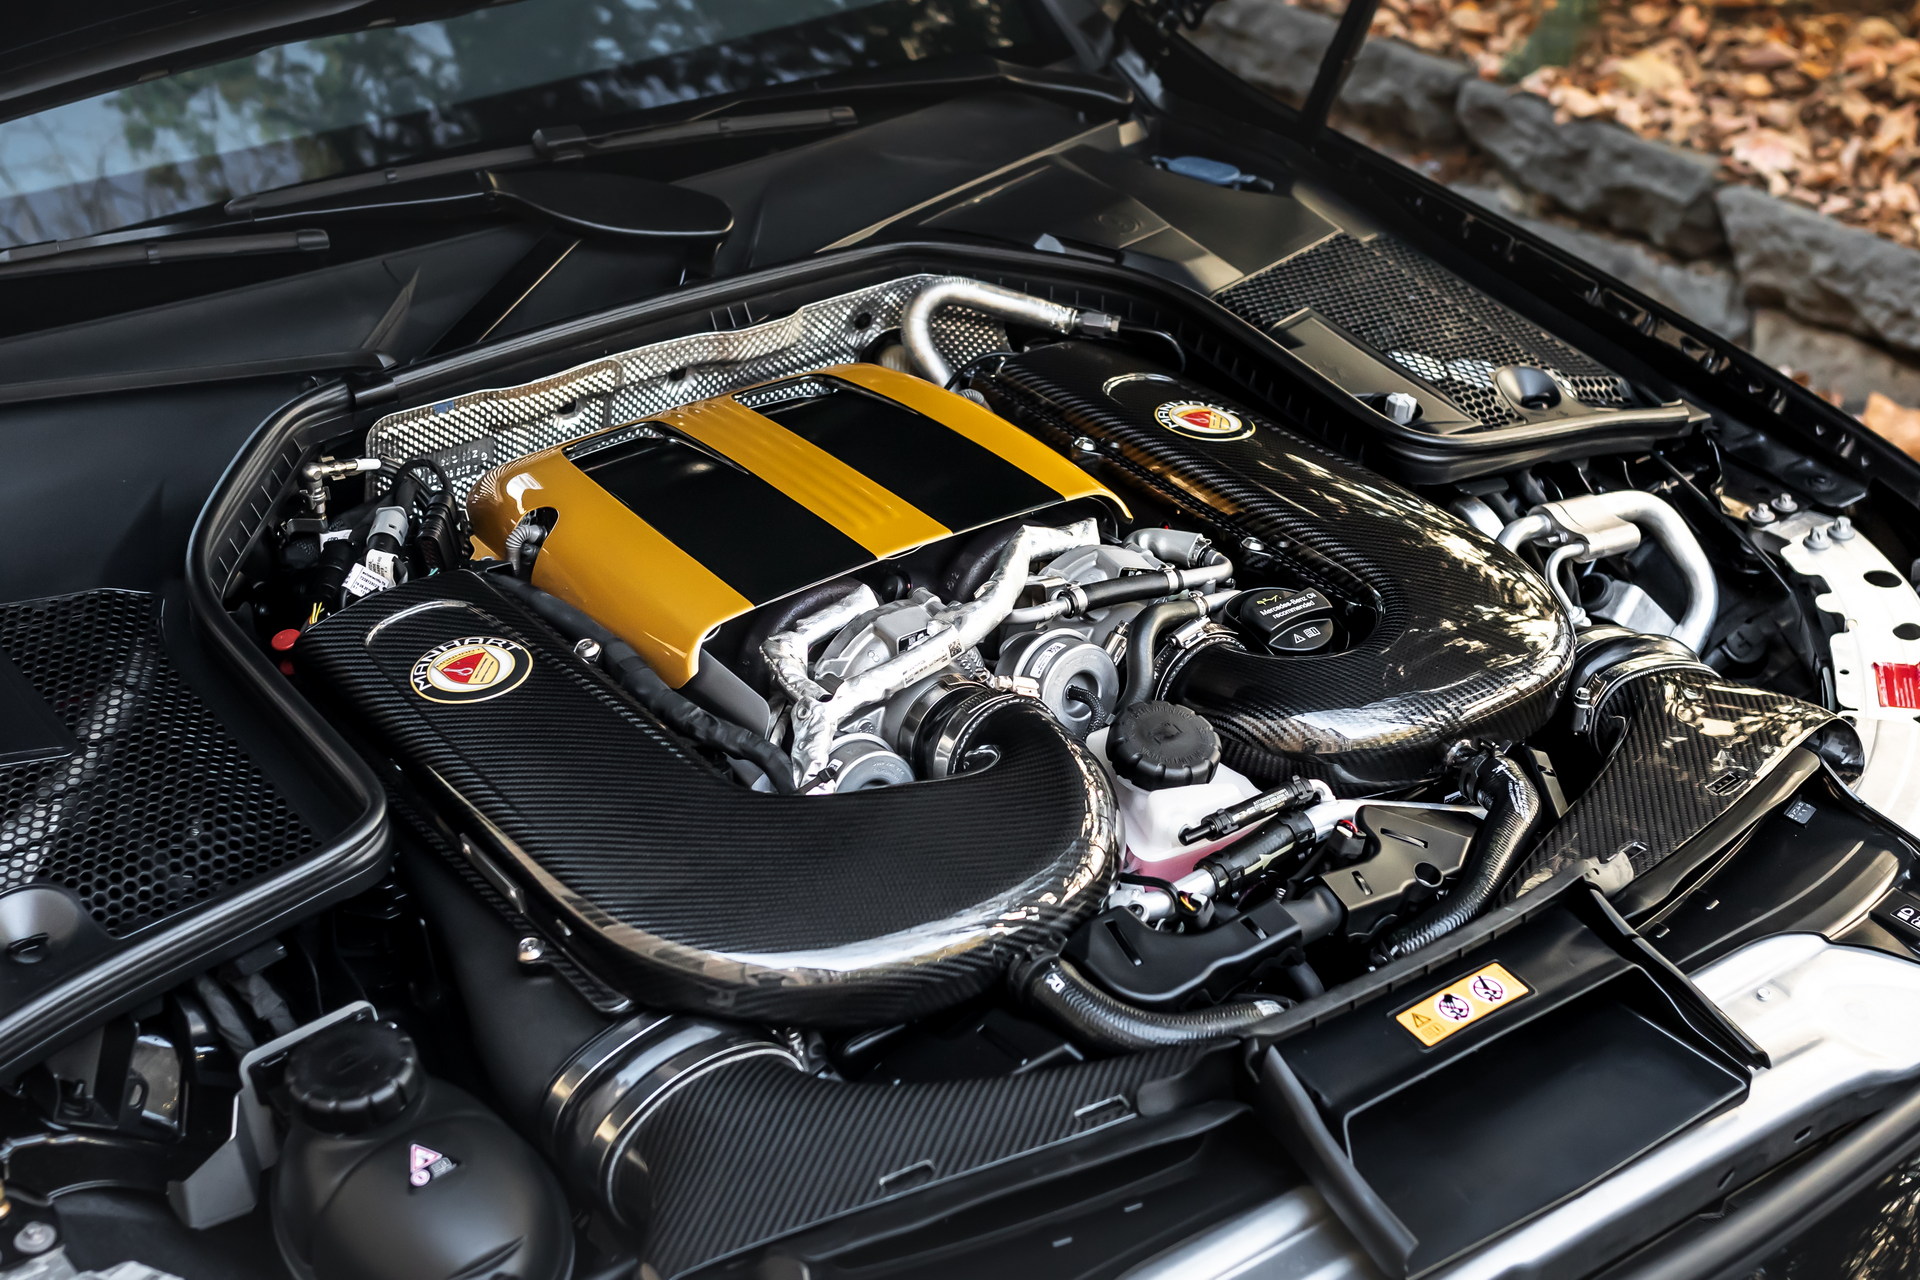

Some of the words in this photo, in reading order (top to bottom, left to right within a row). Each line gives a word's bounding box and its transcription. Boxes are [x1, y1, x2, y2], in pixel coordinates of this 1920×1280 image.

[1260, 596, 1307, 616] Mercedes-Benz
[1306, 592, 1317, 600] Oil
[1272, 600, 1315, 619] recommended
[414, 637, 523, 691] MANHART
